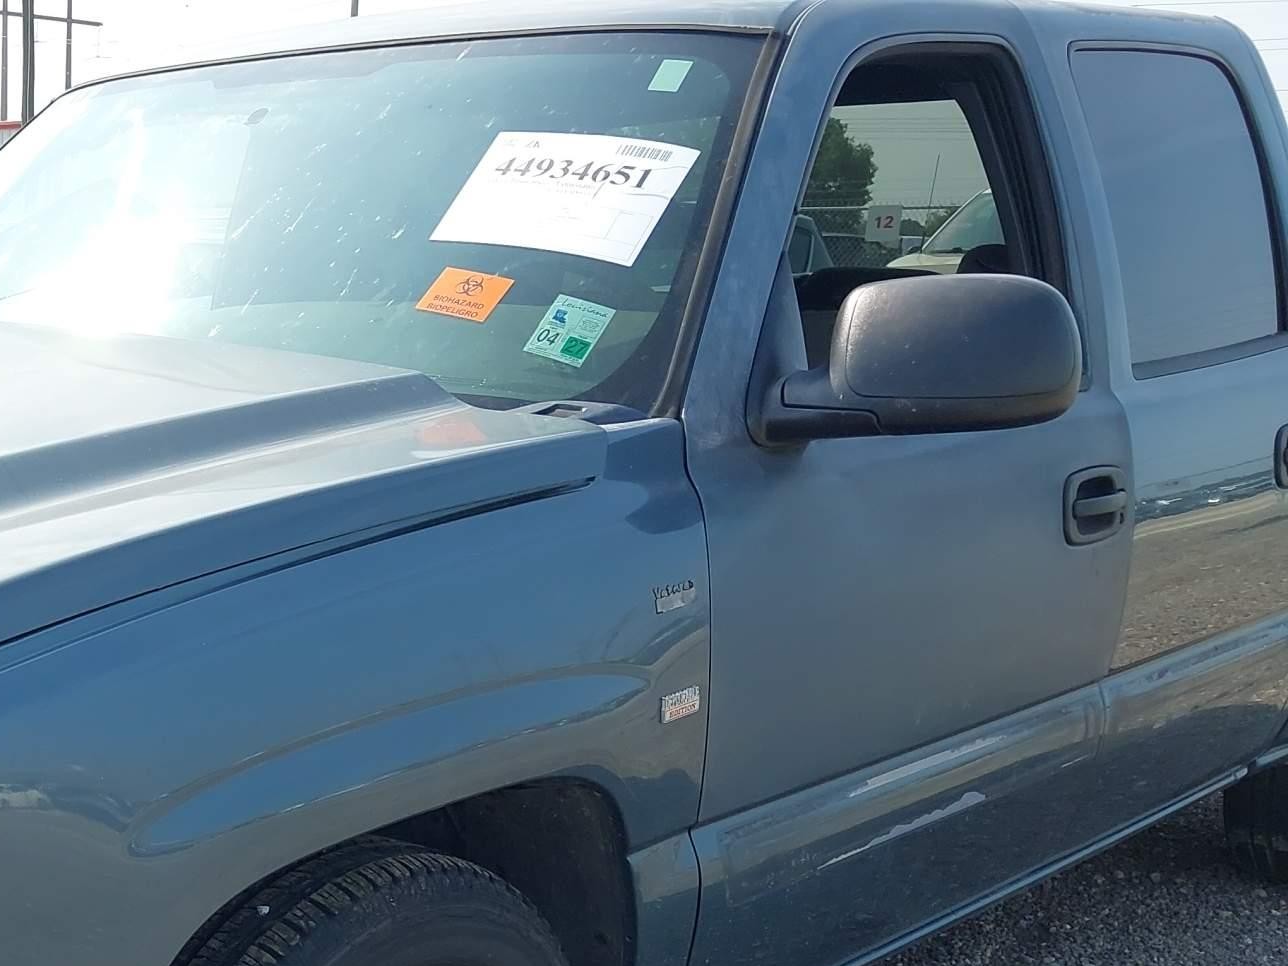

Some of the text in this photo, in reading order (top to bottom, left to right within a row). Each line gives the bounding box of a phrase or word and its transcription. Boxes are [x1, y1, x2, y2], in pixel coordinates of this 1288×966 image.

[495, 156, 653, 189] 44934651
[874, 215, 894, 229] 12
[427, 303, 478, 318] BIOPELIGRO
[433, 295, 484, 310] BIOHAZARD
[536, 328, 560, 346] 04
[564, 338, 590, 355] 27
